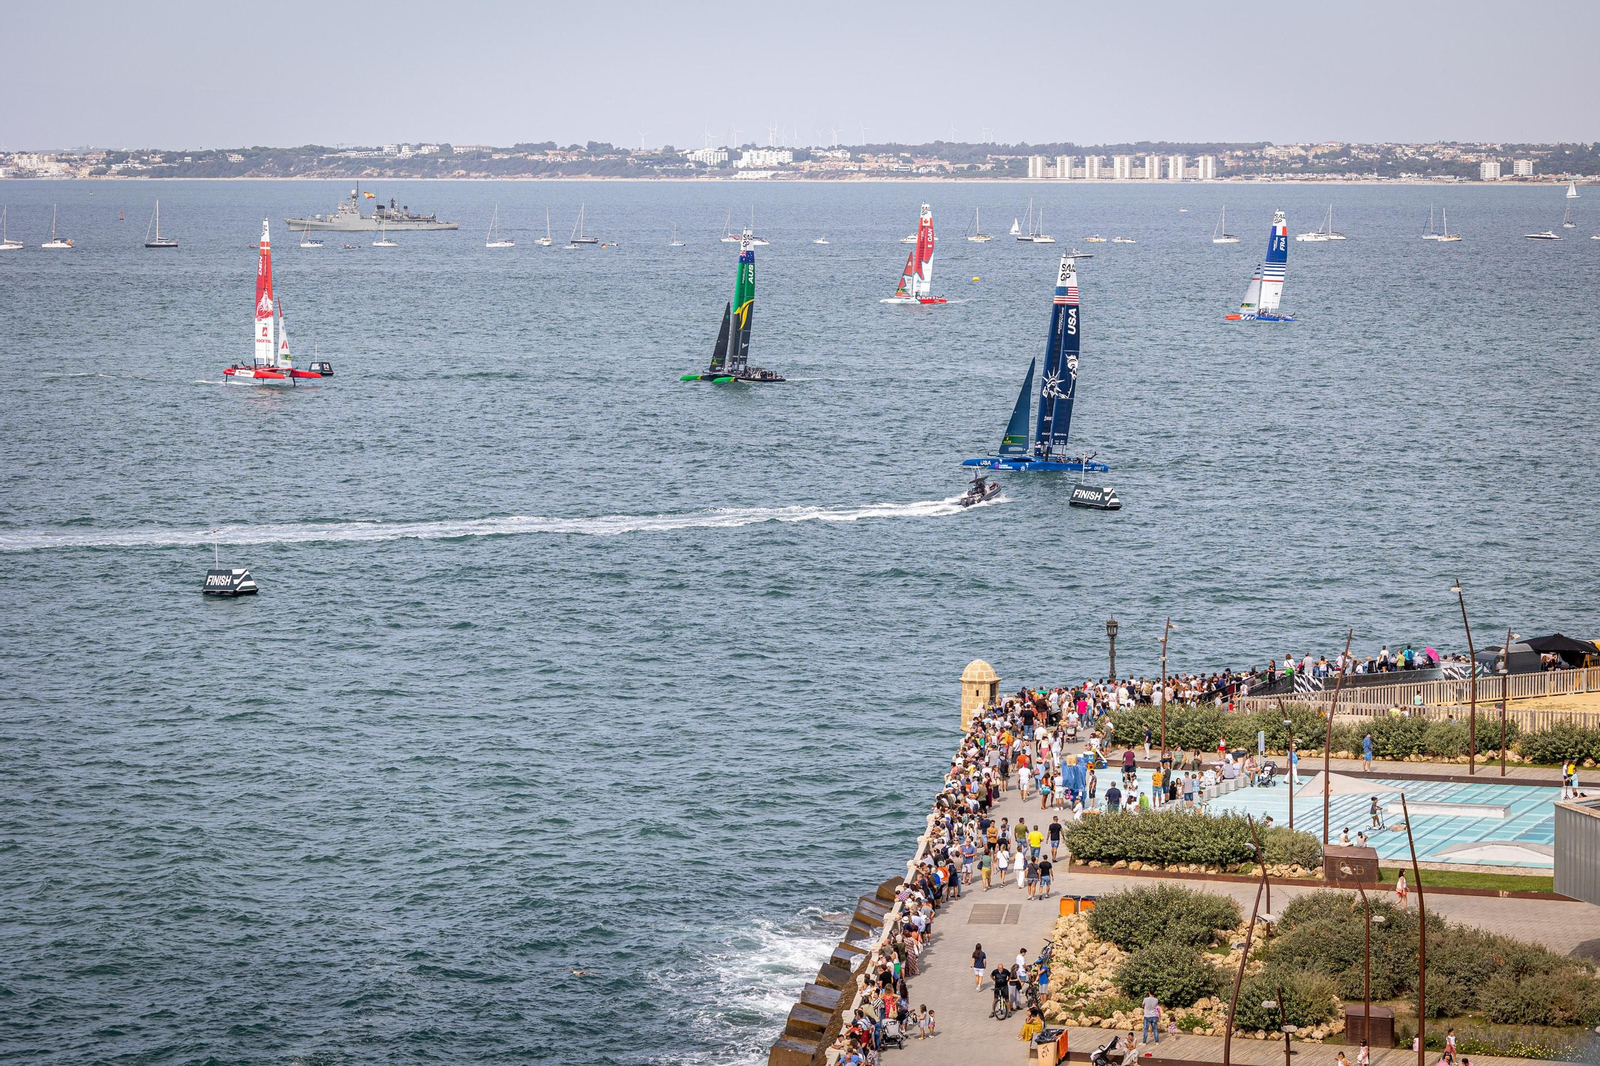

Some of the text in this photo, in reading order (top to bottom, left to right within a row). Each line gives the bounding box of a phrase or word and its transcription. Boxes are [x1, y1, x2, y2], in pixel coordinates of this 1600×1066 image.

[1067, 307, 1077, 335] USA
[1072, 488, 1103, 501] FINISH
[205, 574, 232, 586] FINISH
